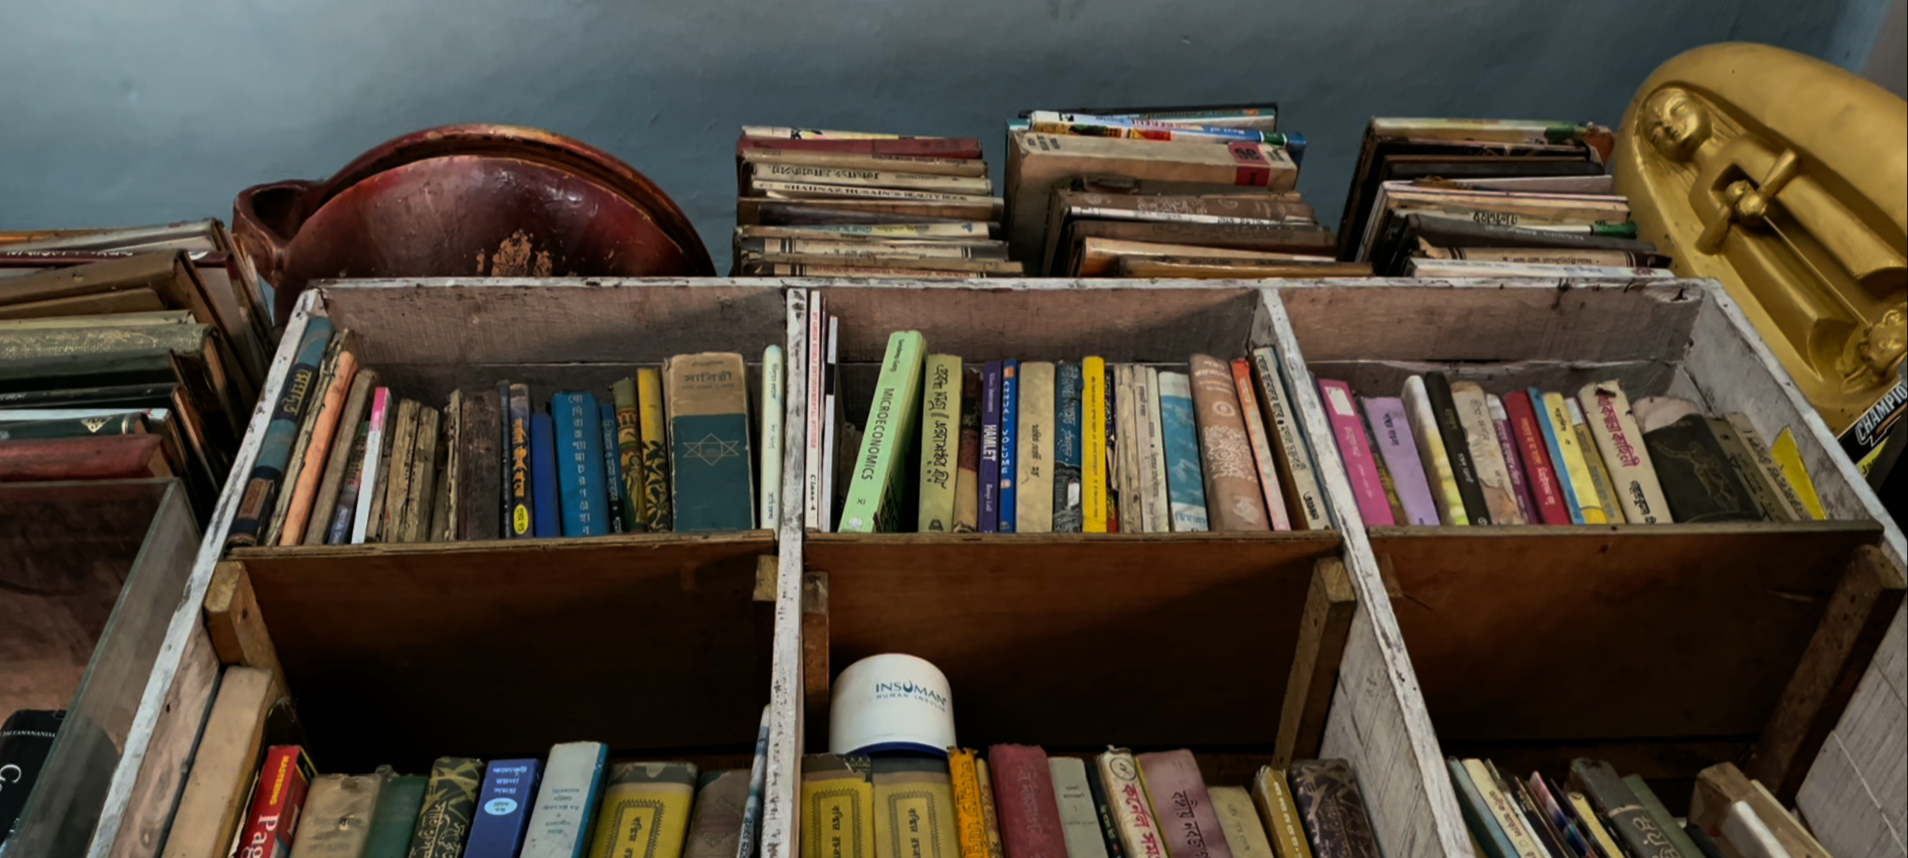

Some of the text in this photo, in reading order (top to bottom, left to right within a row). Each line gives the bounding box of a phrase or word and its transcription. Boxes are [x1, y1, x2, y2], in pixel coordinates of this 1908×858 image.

[861, 387, 895, 480] MICROECONOMICS
[983, 424, 997, 461] HAMLET
[1001, 380, 1011, 475] ANNUAL VOLUME
[875, 679, 947, 706] INSUMAN
[1121, 783, 1153, 828] কর্নেল
